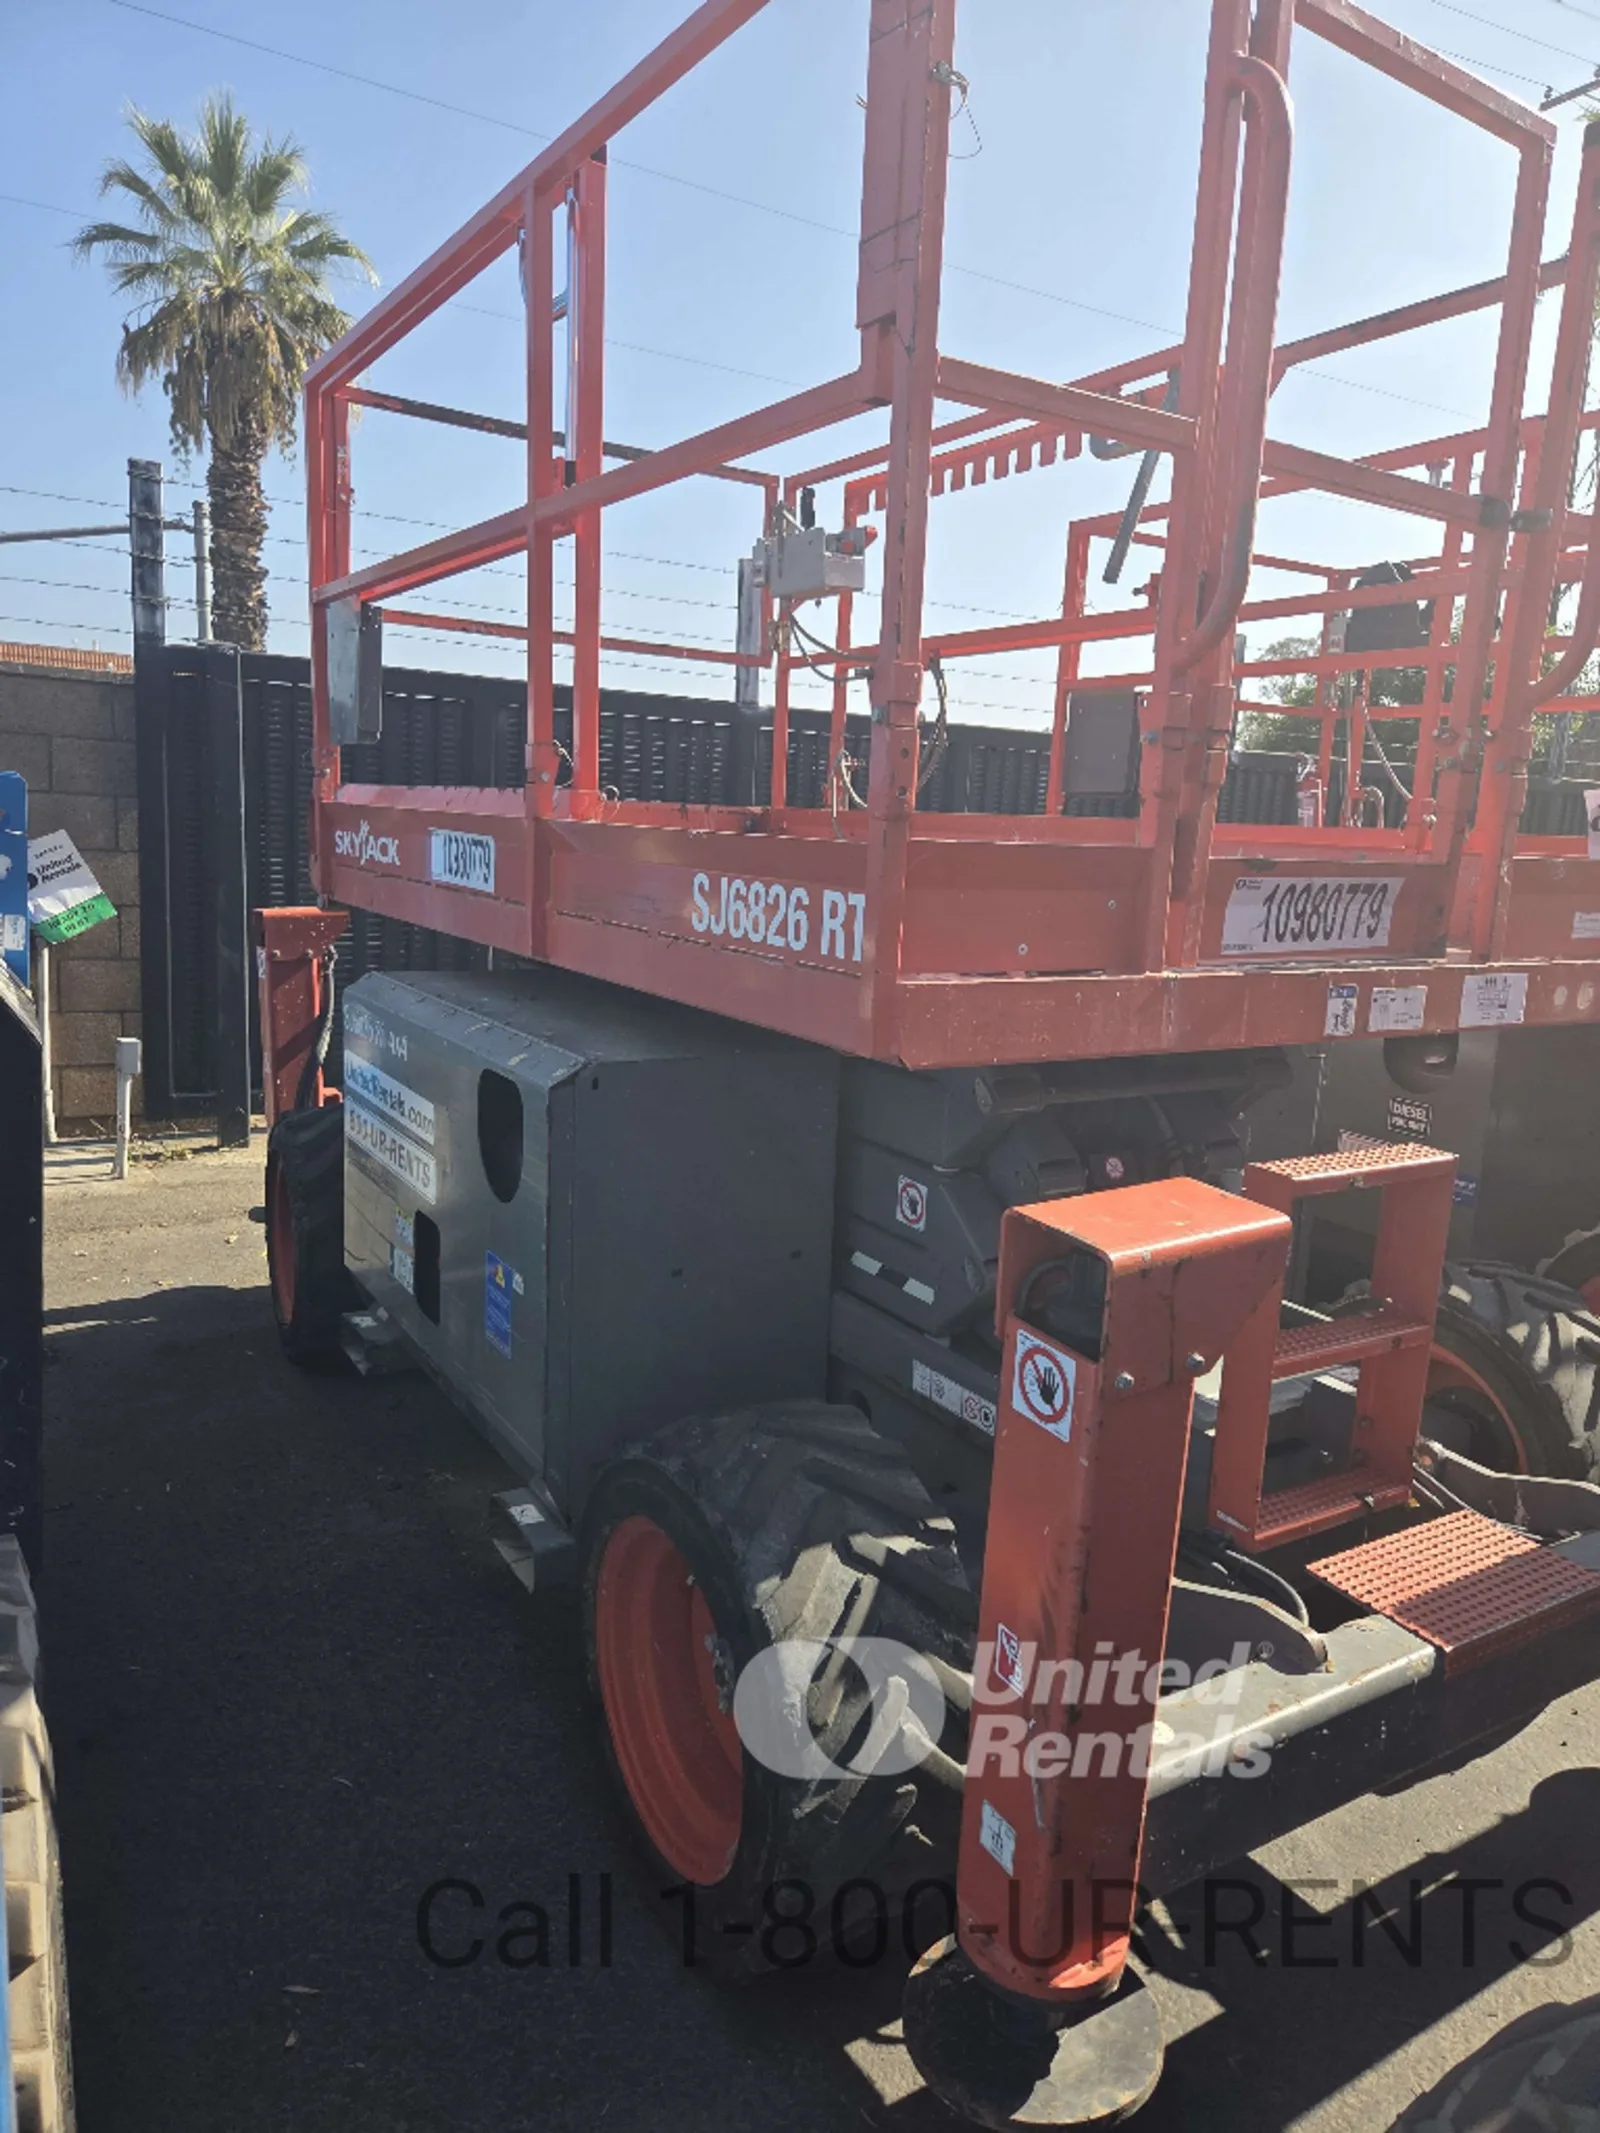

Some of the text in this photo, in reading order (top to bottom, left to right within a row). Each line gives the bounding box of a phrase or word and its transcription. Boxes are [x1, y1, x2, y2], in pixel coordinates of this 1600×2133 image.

[691, 872, 866, 962] SJ6826 RT
[1262, 883, 1389, 943] 10980779
